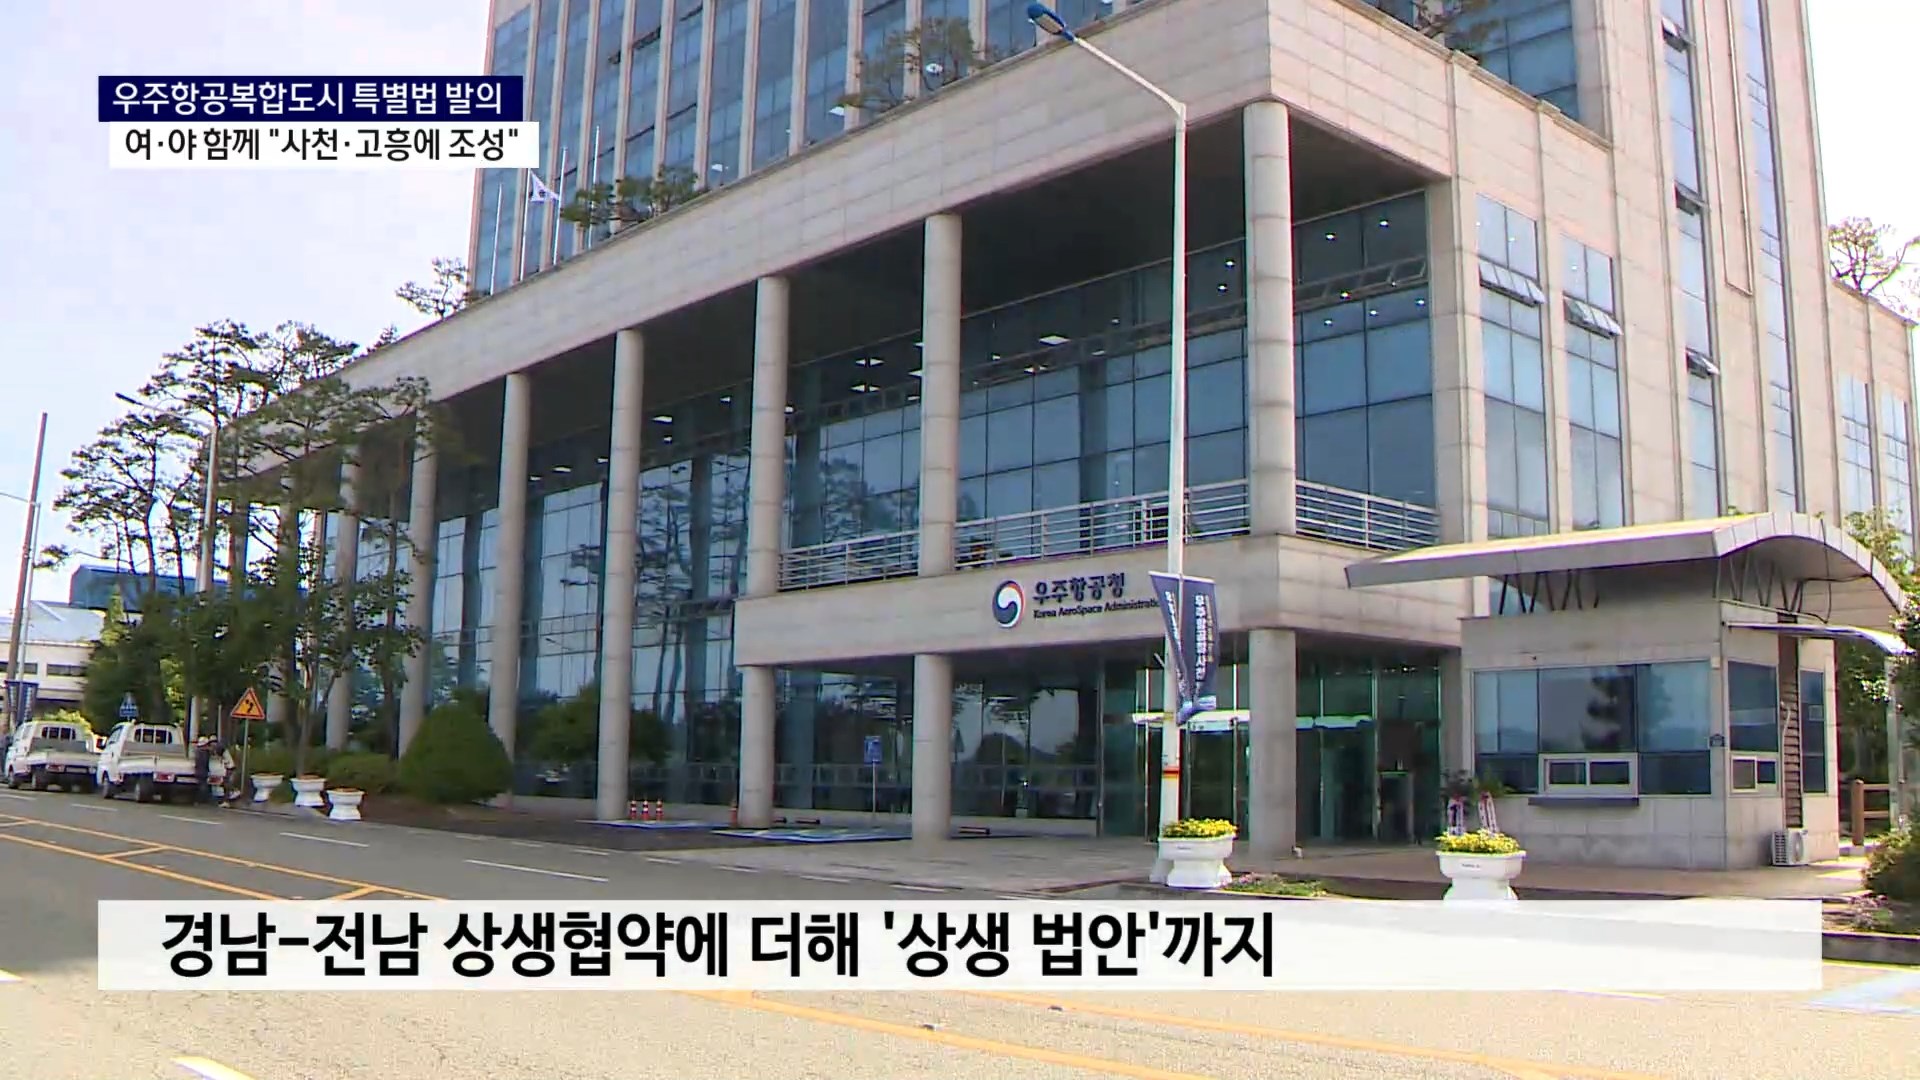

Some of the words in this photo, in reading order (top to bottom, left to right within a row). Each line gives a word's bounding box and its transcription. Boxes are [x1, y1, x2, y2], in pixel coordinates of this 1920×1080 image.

[1033, 572, 1125, 605] 우주항공청
[1033, 609, 1056, 619] Korea
[1058, 604, 1103, 617] AeroSpace
[1104, 598, 1160, 613] Administratio
